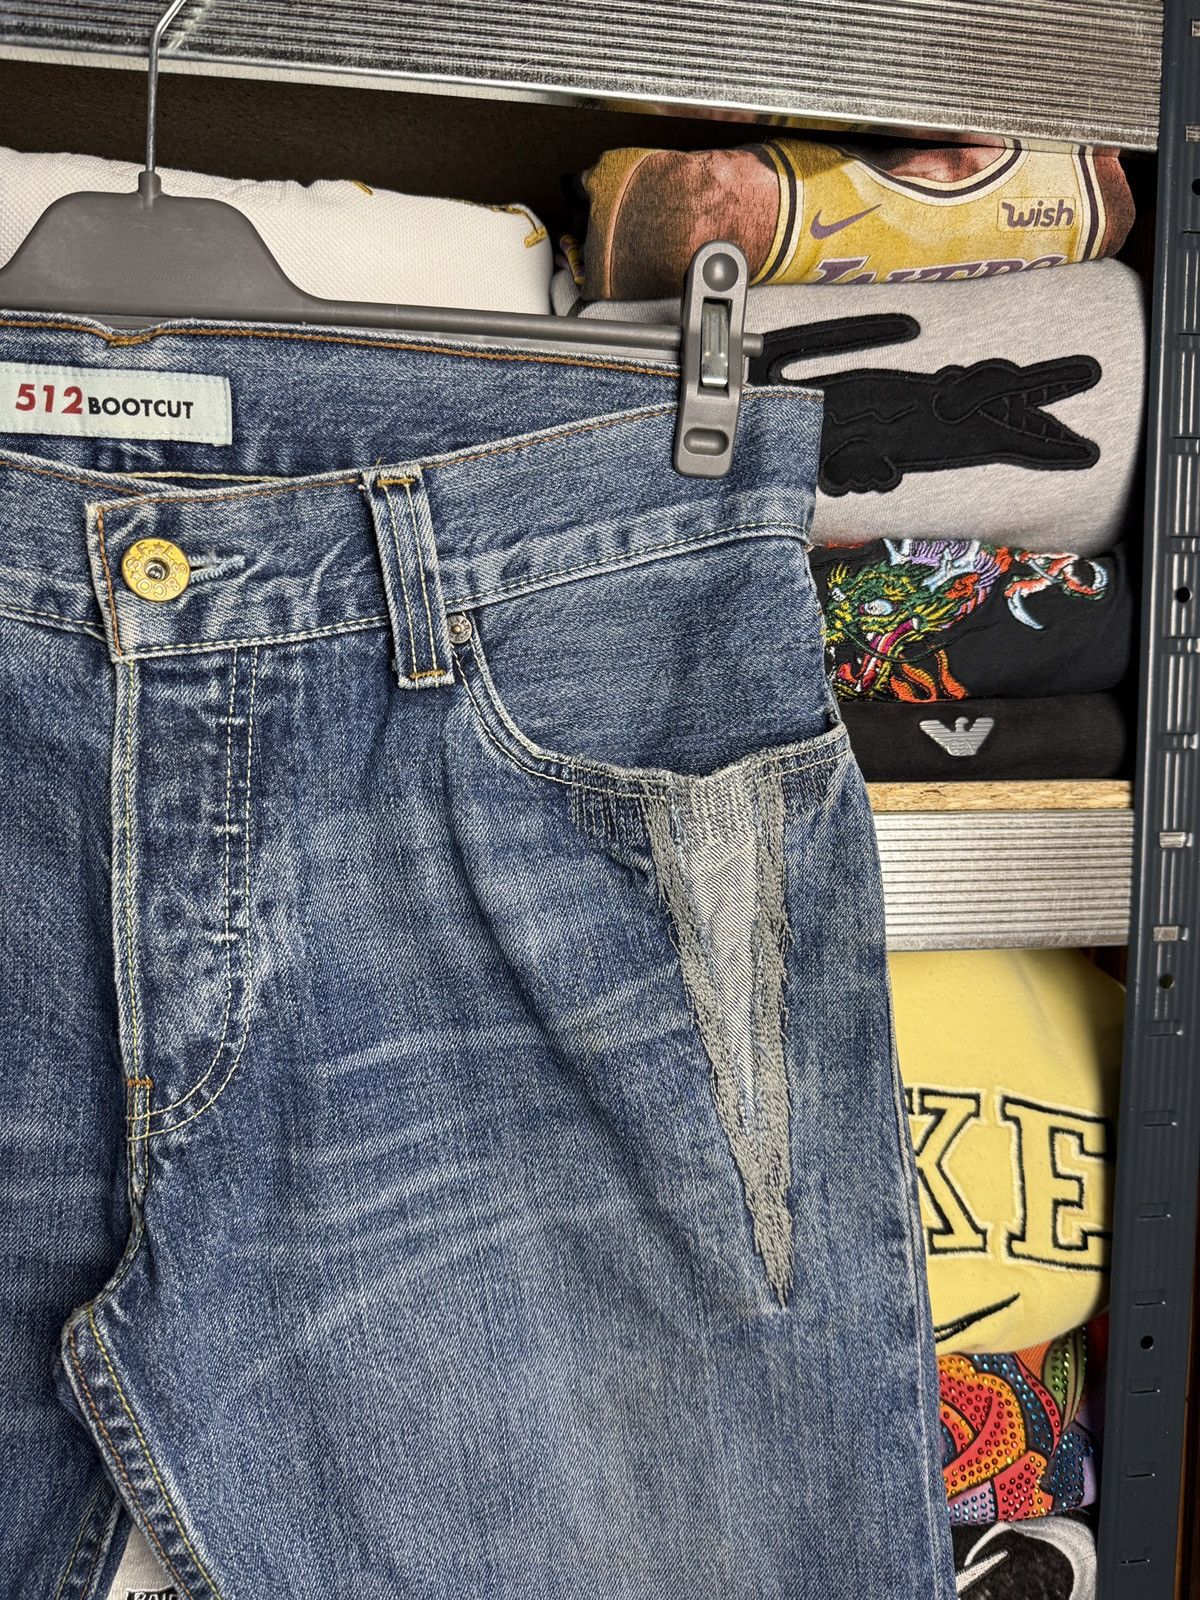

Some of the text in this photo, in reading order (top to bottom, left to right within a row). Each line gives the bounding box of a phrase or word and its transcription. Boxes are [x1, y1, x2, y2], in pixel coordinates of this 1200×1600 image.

[1001, 199, 1074, 228] wish
[15, 383, 194, 419] 512 BOOTCUT
